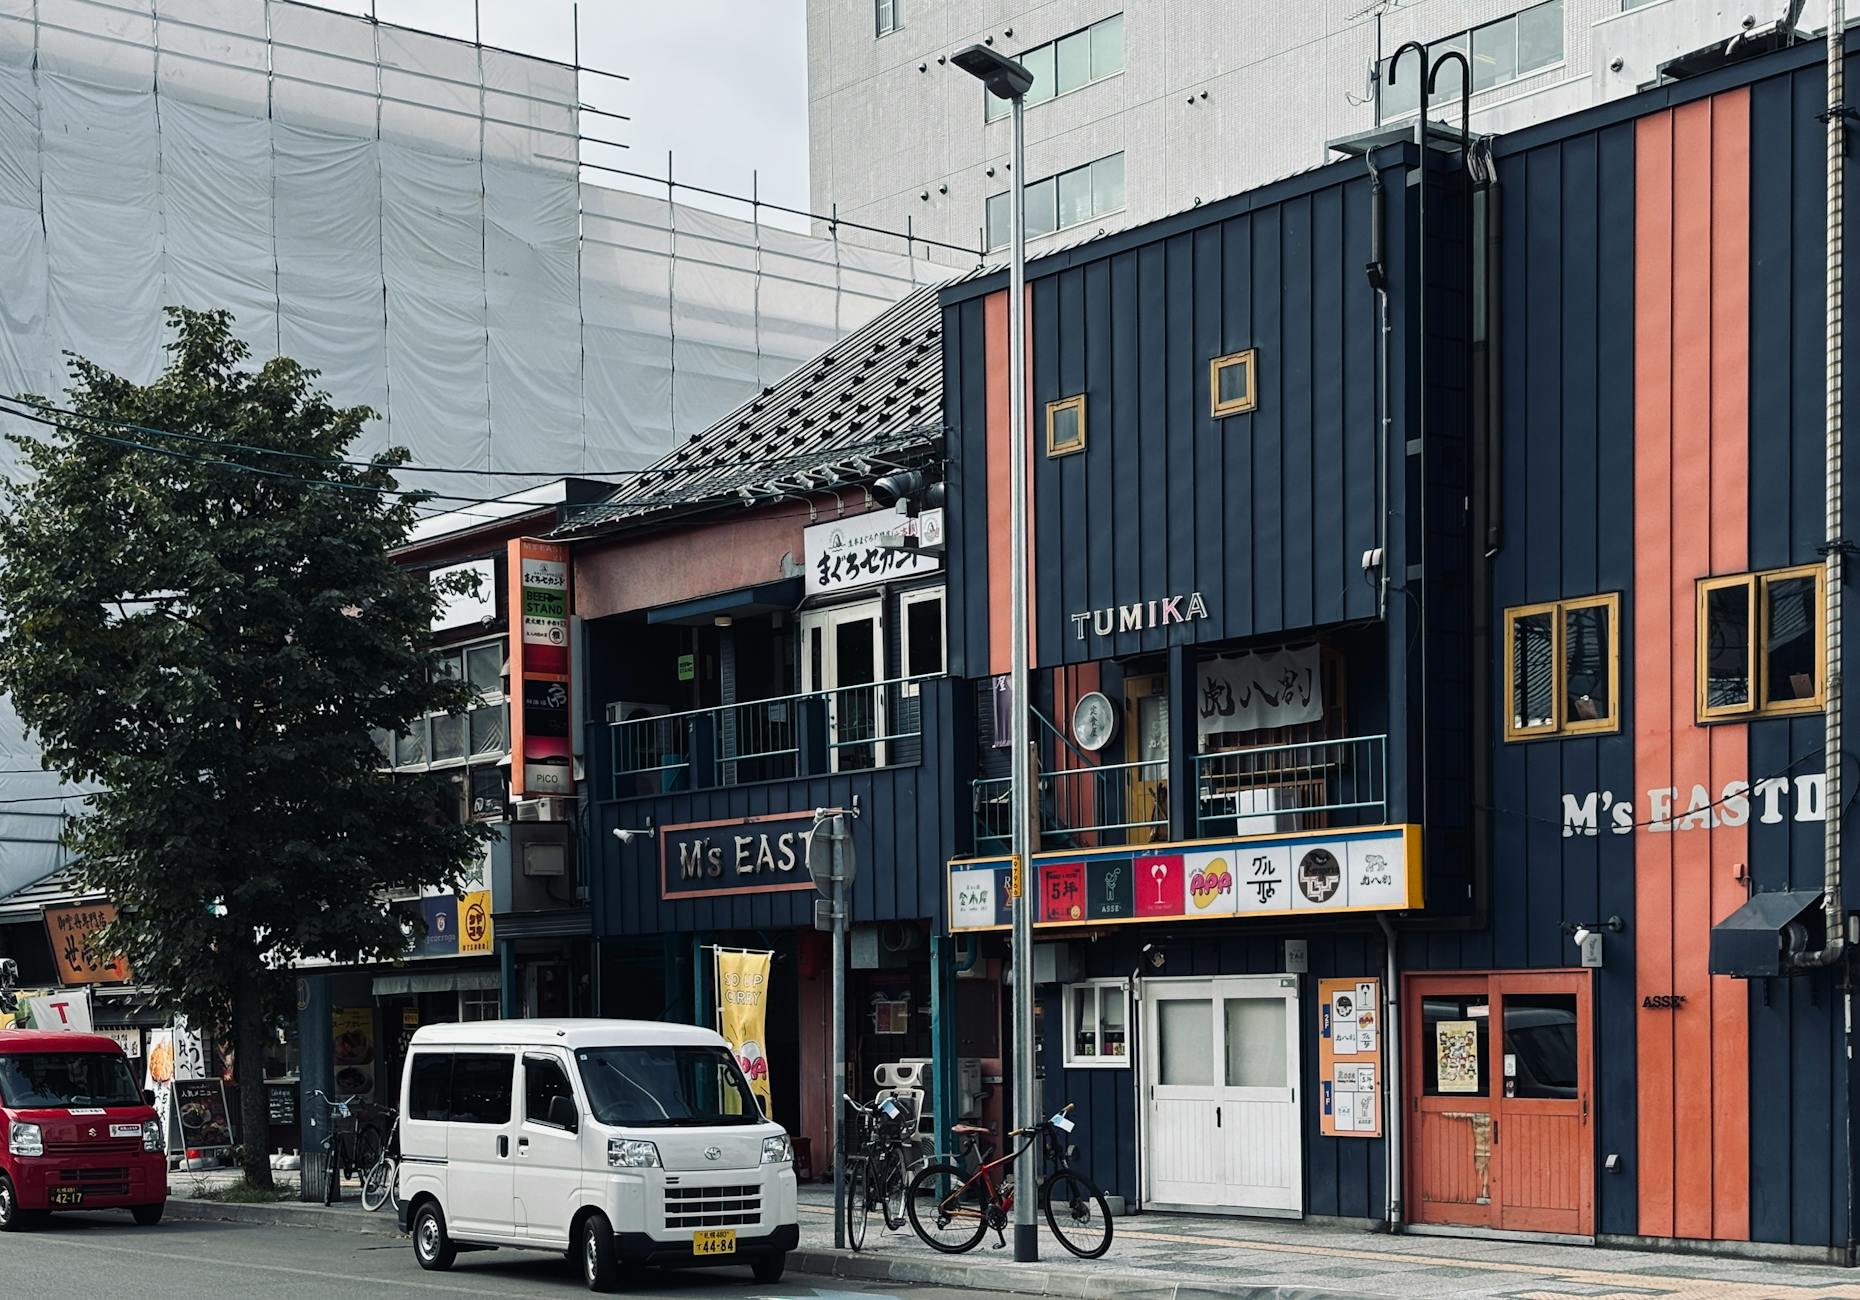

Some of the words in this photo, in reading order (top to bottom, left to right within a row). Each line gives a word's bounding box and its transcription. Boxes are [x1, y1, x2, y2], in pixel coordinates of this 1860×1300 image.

[523, 573, 566, 586] まぐろセカンド
[526, 603, 563, 615] STAND
[1071, 591, 1209, 640] TUMIKA
[536, 774, 559, 784] PICO
[1562, 790, 1633, 838] M's
[678, 836, 722, 880] M's
[734, 830, 812, 876] EAST
[1051, 880, 1079, 901] 5坪
[1101, 904, 1120, 913] ASSE
[724, 972, 763, 988] SOUP
[725, 990, 762, 1006] CURRY
[55, 1193, 83, 1205] 42-17
[703, 1238, 734, 1254] 44-84
